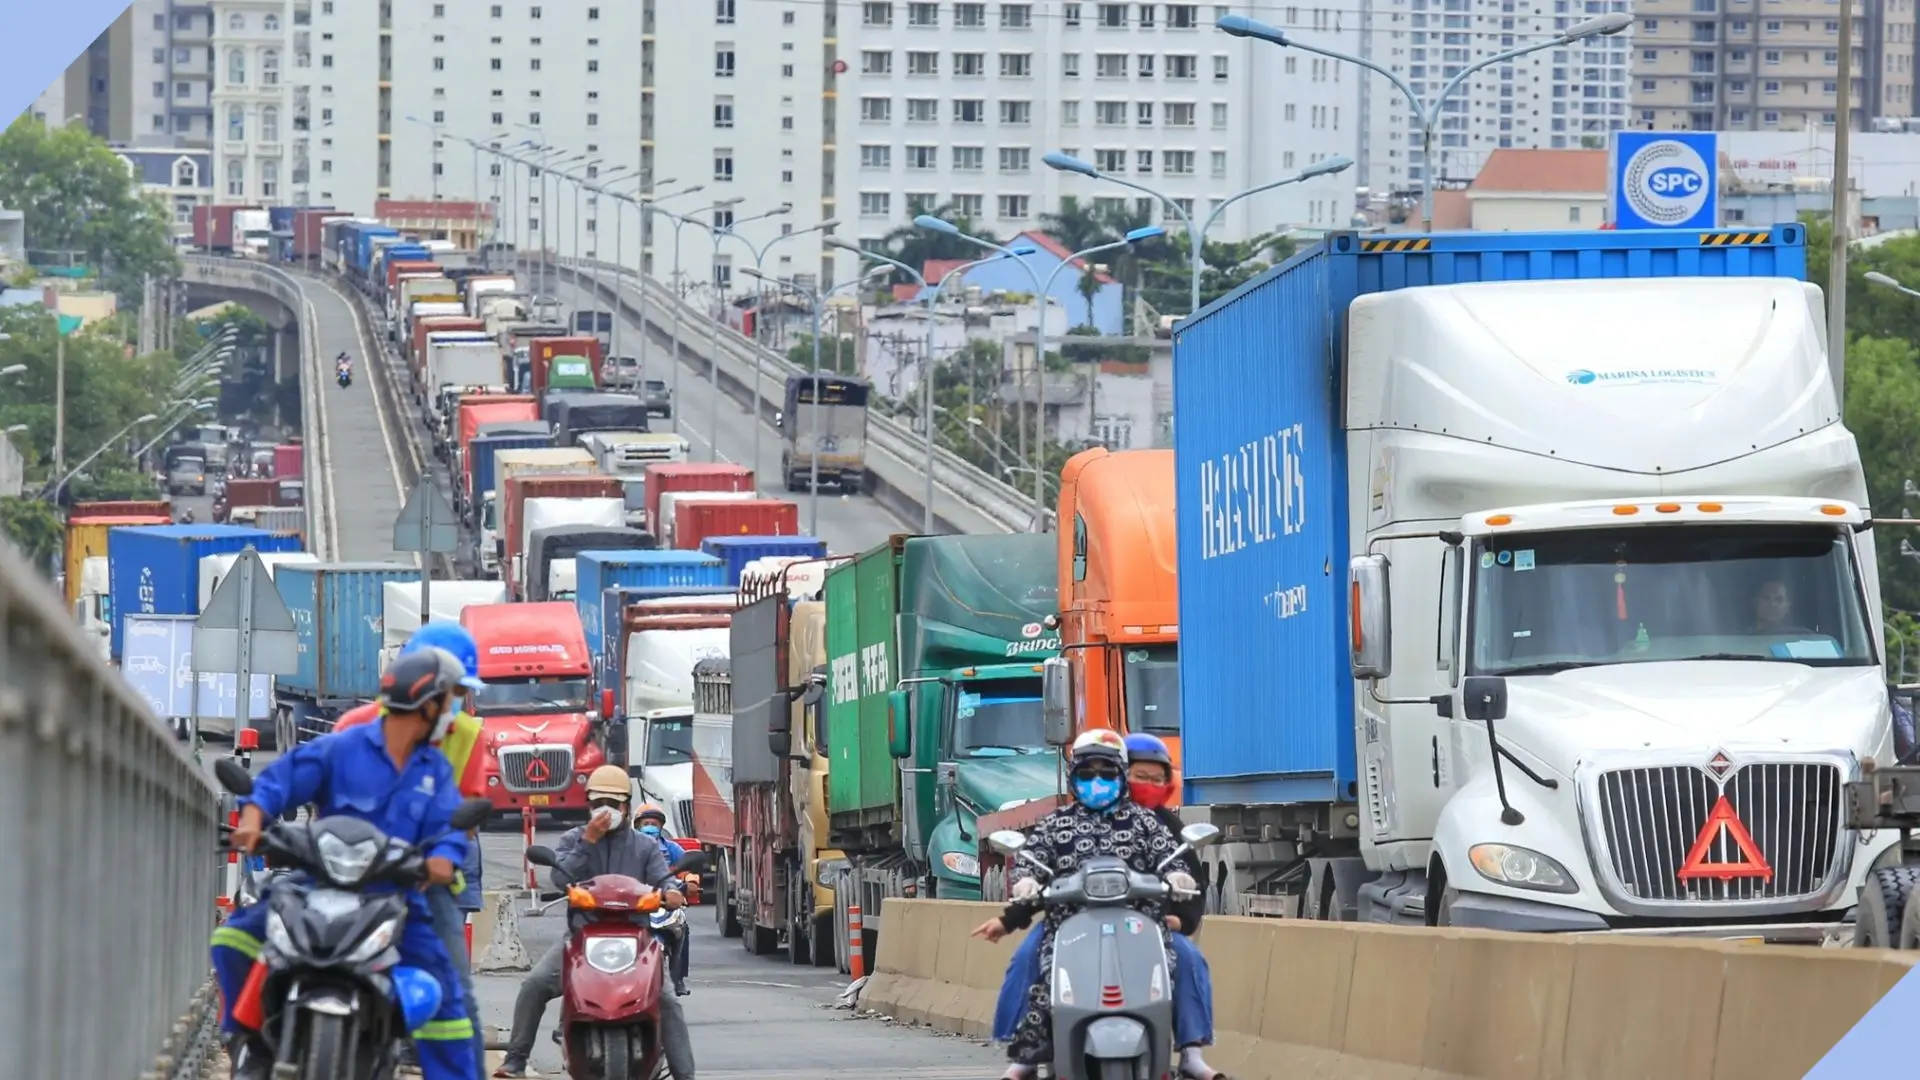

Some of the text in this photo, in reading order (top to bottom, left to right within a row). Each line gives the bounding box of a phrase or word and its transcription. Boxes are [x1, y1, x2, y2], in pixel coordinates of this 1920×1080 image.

[1652, 173, 1699, 192] SPC
[1597, 369, 1716, 380] MARINA LOGISTICS
